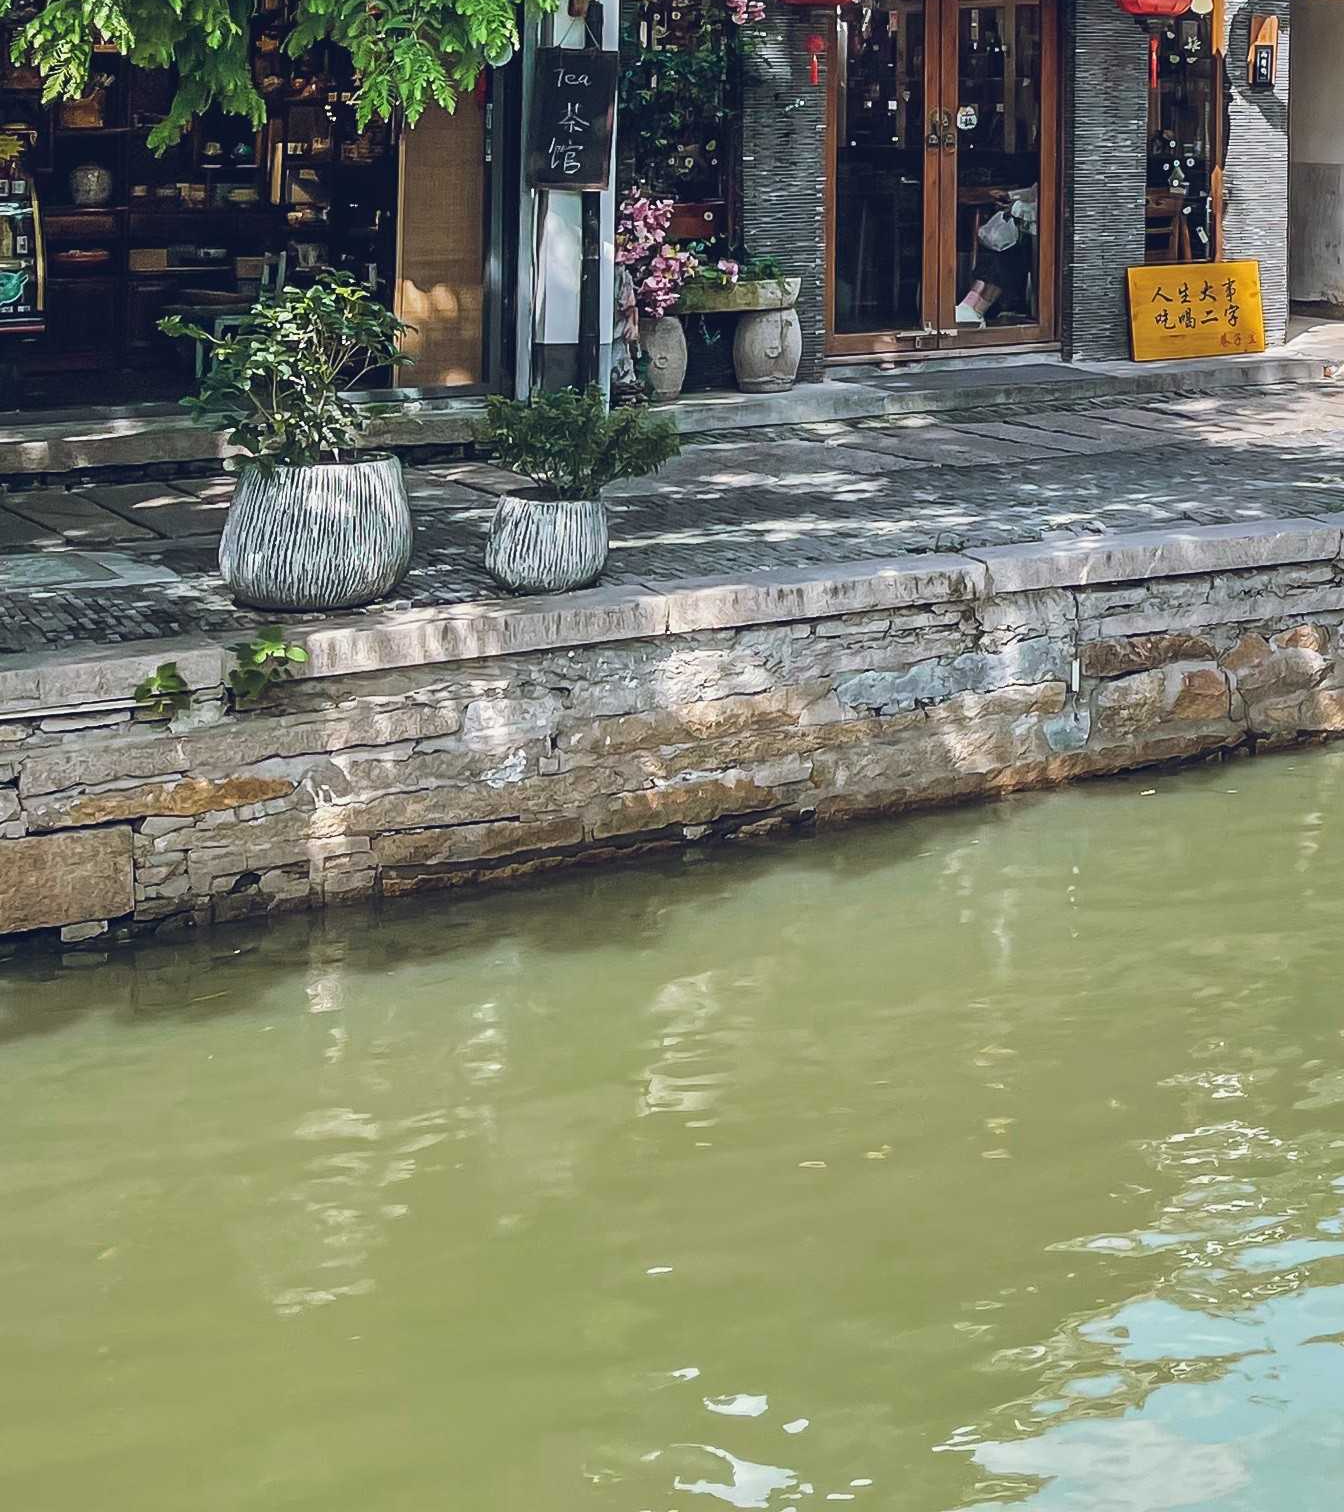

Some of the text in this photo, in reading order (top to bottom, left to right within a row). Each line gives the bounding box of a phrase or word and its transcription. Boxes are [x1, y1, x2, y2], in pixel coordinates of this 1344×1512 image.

[553, 68, 592, 87] Tea
[549, 102, 591, 174] 茶馆
[1151, 278, 1236, 304] 人生大事
[1154, 304, 1240, 330] 吃喝二字
